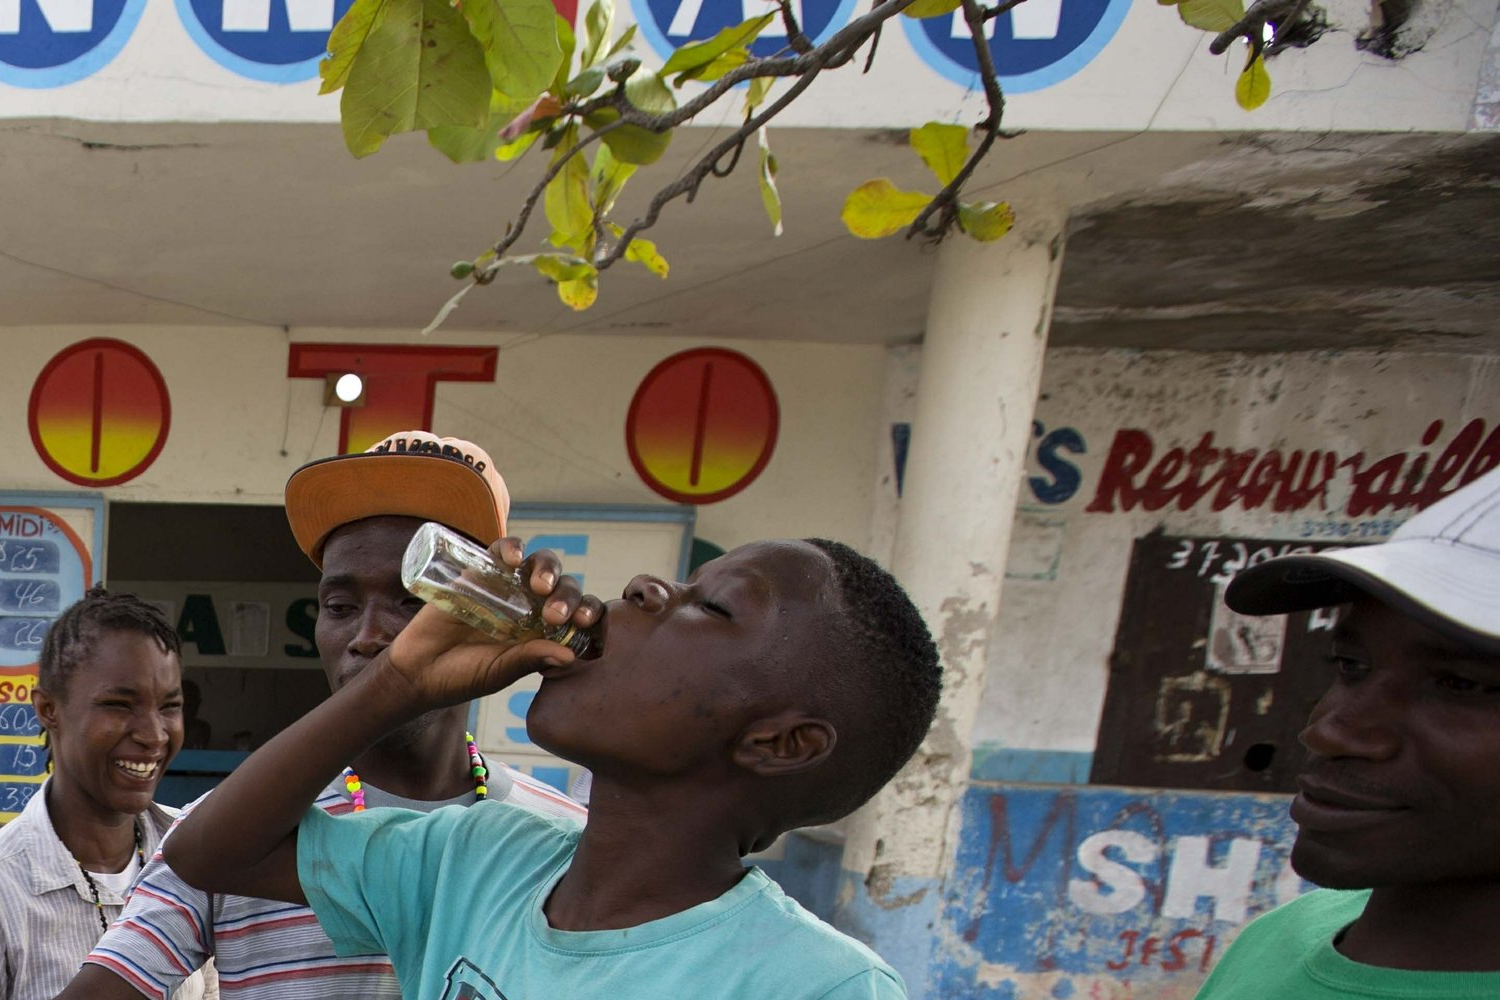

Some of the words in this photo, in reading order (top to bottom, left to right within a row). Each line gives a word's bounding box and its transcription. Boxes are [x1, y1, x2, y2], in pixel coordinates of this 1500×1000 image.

[15, 582, 46, 608] 46
[14, 620, 46, 646] 26
[1069, 829, 1301, 922] SH
